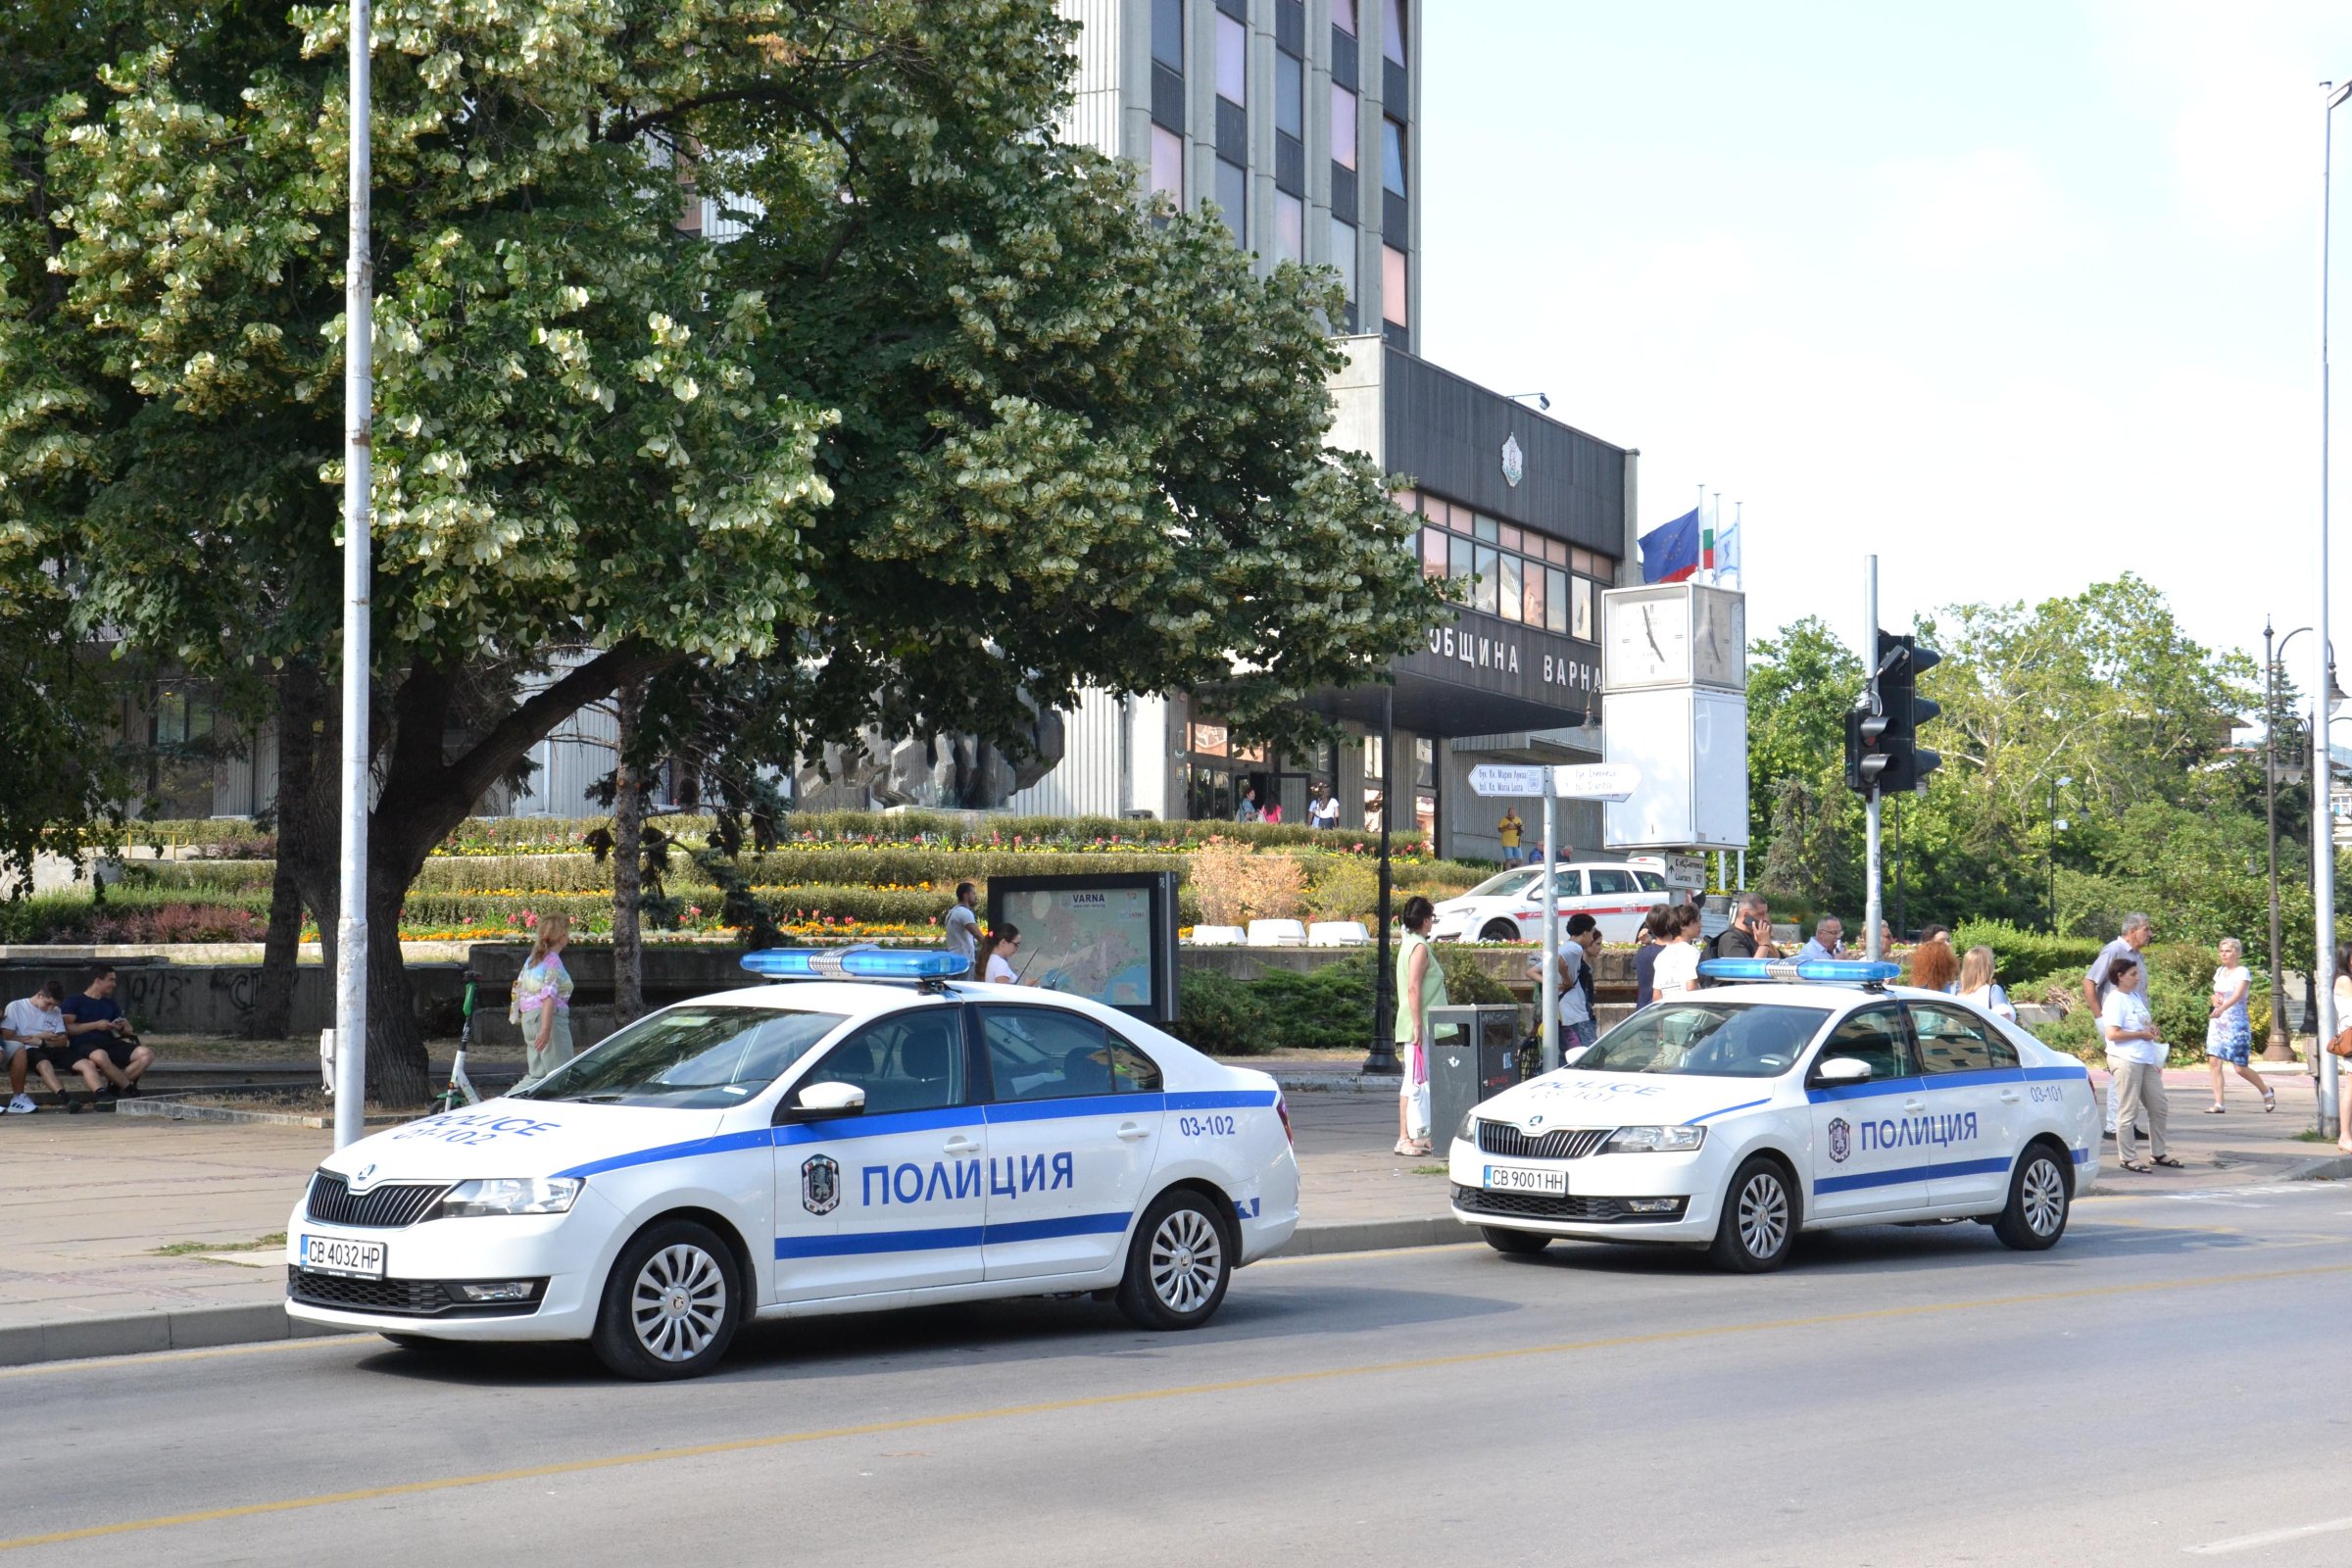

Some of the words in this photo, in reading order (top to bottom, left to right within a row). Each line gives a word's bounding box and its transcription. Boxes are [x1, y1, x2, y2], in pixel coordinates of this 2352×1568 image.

[1430, 626, 1519, 674] ОБЩИНА
[1543, 654, 1603, 694] ВАРНА
[1072, 893, 1105, 903] VARNA
[2030, 1085, 2064, 1102] 03-101
[399, 1114, 563, 1137] POLICE
[1179, 1115, 1236, 1137] 03-102
[1860, 1111, 1978, 1151] ПОЛИЦИЯ
[861, 1151, 1073, 1206] ПОЛИЦИЯ
[1511, 1171, 1542, 1189] 9001
[327, 1243, 359, 1268] 4032
